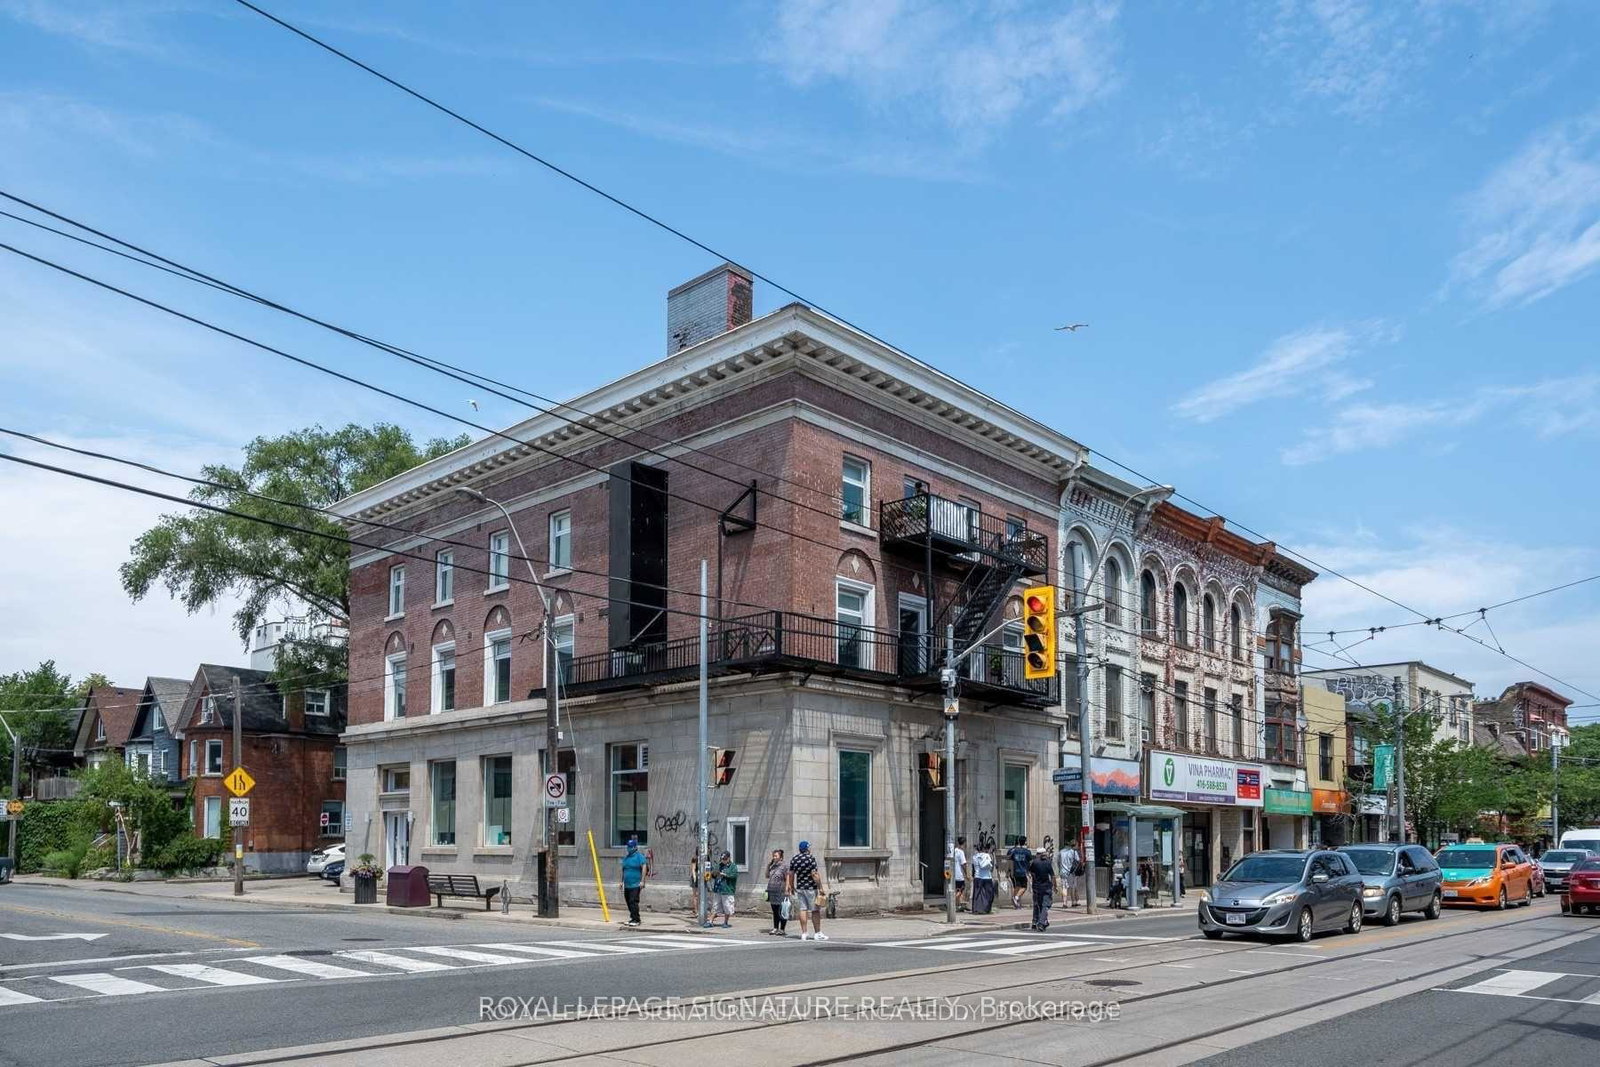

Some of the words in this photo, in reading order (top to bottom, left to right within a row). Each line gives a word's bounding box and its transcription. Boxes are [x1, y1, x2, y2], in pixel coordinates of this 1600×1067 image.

[1188, 763, 1203, 776] VINA
[1204, 764, 1234, 780] PHARMACY
[232, 807, 247, 817] 40
